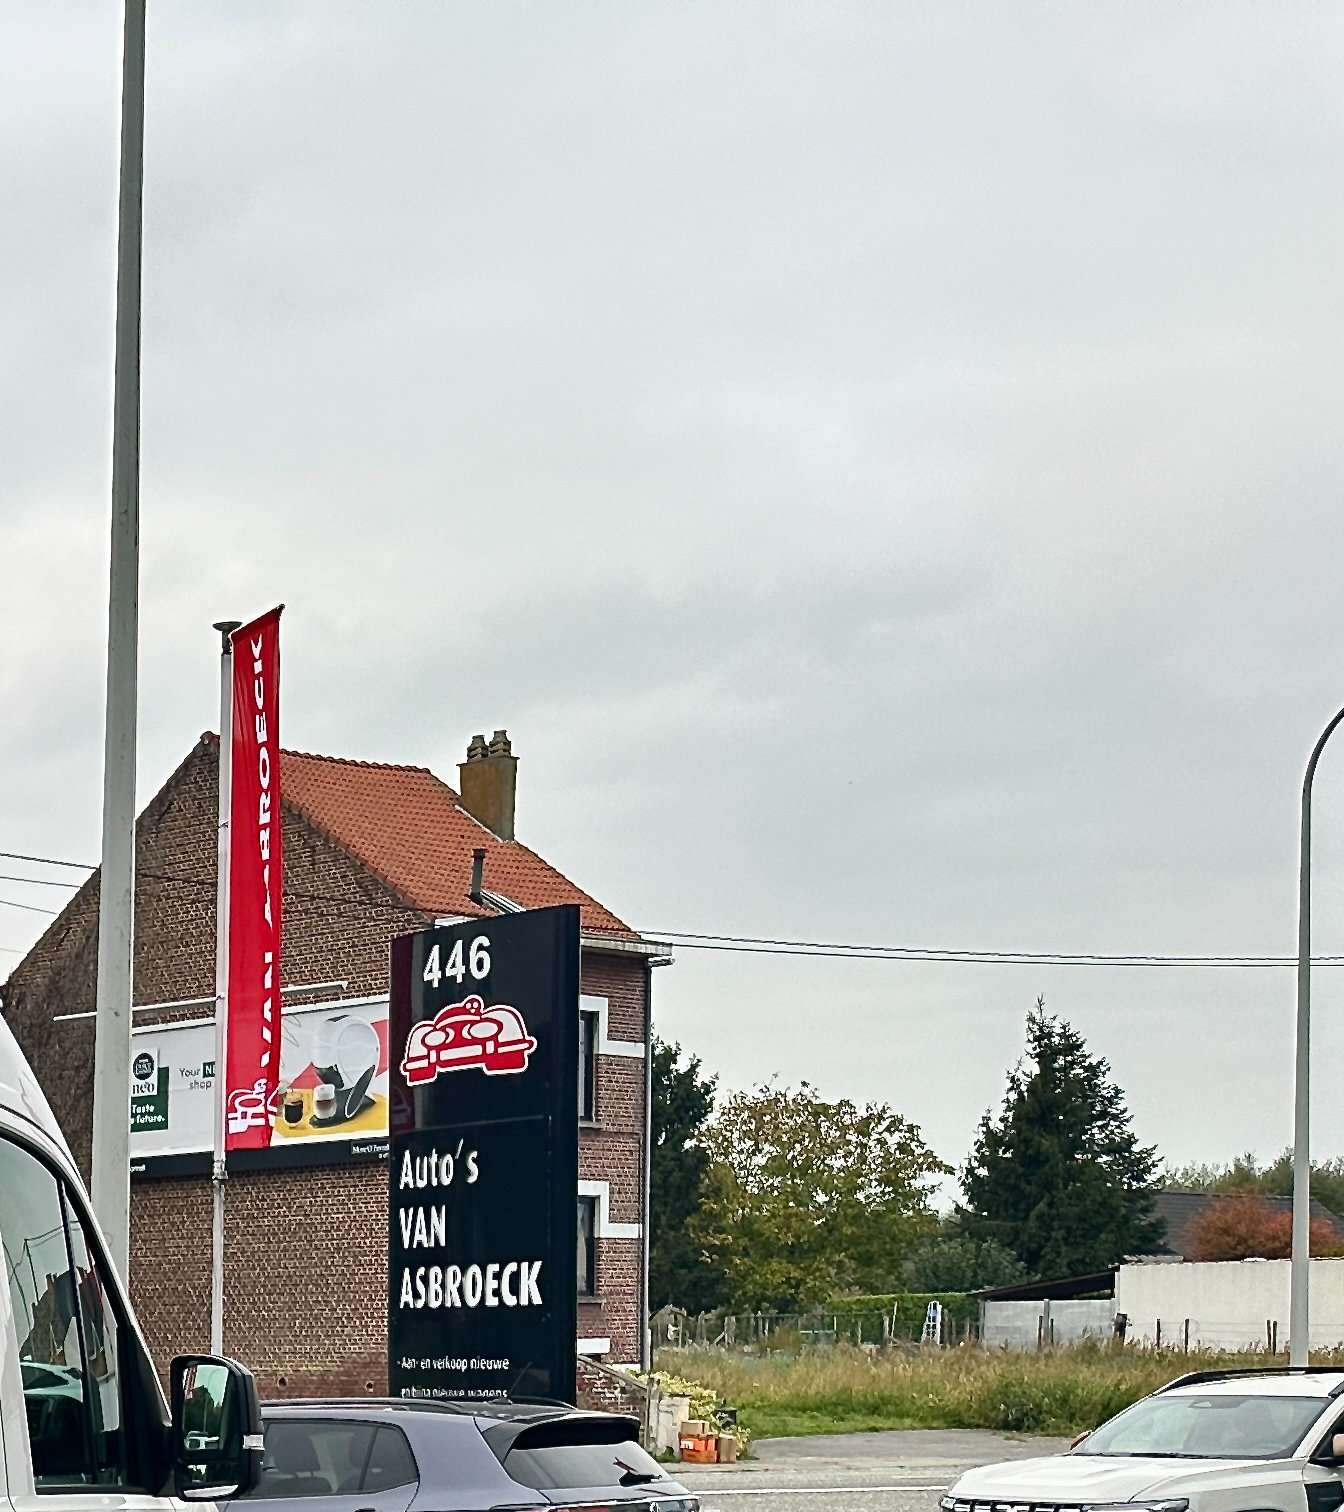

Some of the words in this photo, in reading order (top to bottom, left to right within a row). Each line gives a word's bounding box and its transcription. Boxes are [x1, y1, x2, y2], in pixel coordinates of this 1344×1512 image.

[423, 935, 491, 988] 446
[179, 1067, 201, 1078] Your
[189, 1080, 212, 1091] shop
[132, 1104, 155, 1114] Taste
[399, 1138, 479, 1190] Auto's
[399, 1204, 446, 1249] VAN
[399, 1260, 543, 1309] ASBROECK
[432, 1355, 468, 1373] verkoop
[470, 1355, 510, 1370] nieuwe
